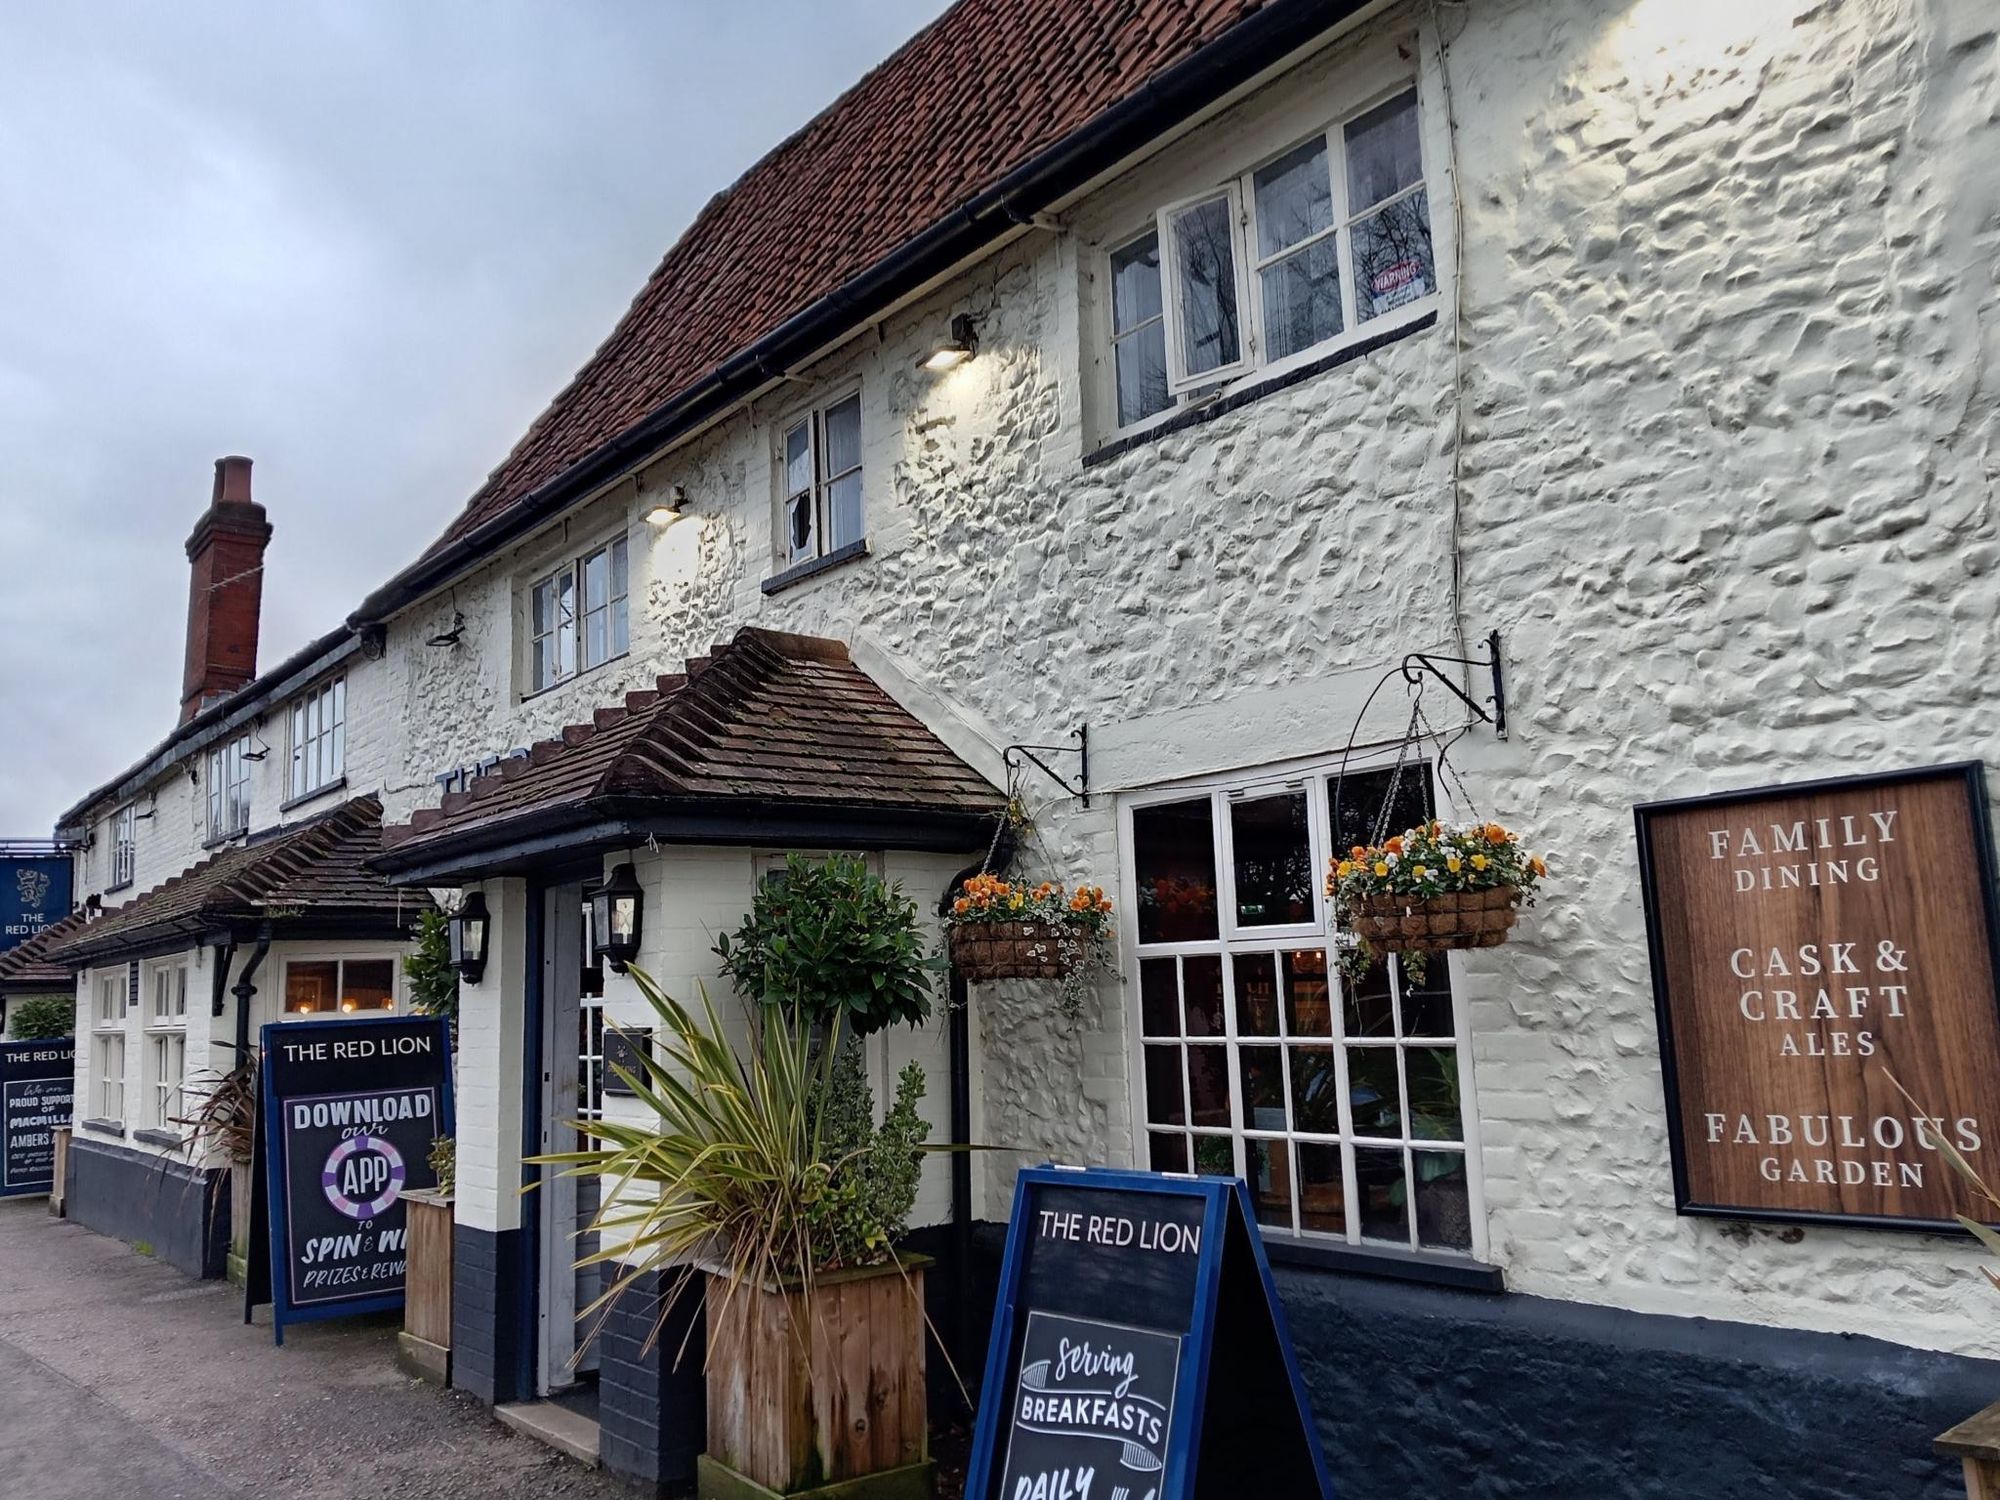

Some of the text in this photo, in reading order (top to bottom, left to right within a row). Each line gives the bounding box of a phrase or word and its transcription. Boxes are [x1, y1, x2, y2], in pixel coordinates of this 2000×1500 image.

[1374, 262, 1417, 291] WARNING
[1709, 810, 1899, 860] FAMILY
[1735, 857, 1881, 893] DINING
[5, 925, 29, 935] RED
[21, 913, 45, 923] THE
[1730, 939, 1908, 979] CASK &
[1739, 985, 1908, 1021] CRAFT
[5, 1052, 30, 1063] THE
[33, 1050, 58, 1062] RED
[283, 1036, 431, 1062] THE RED LION
[1780, 1031, 1877, 1057] ALES
[9, 1096, 39, 1108] PROUD
[41, 1105, 55, 1113] OF
[294, 1094, 431, 1129] DOWNLOAD
[10, 1132, 49, 1149] AMBERS
[341, 1122, 388, 1140] our
[1704, 1112, 1982, 1152] FABULOUS
[343, 1156, 388, 1196] APP
[1759, 1157, 1924, 1189] GARDEN
[358, 1220, 373, 1231] TO
[1039, 1210, 1202, 1255] THE RED LION
[301, 1233, 361, 1264] SPIN
[363, 1236, 374, 1252] &
[303, 1265, 362, 1288] PRIZES
[1055, 1336, 1140, 1400] Serving
[1021, 1395, 1163, 1445] BREAKFASTS
[1013, 1465, 1095, 1500] DAILY
